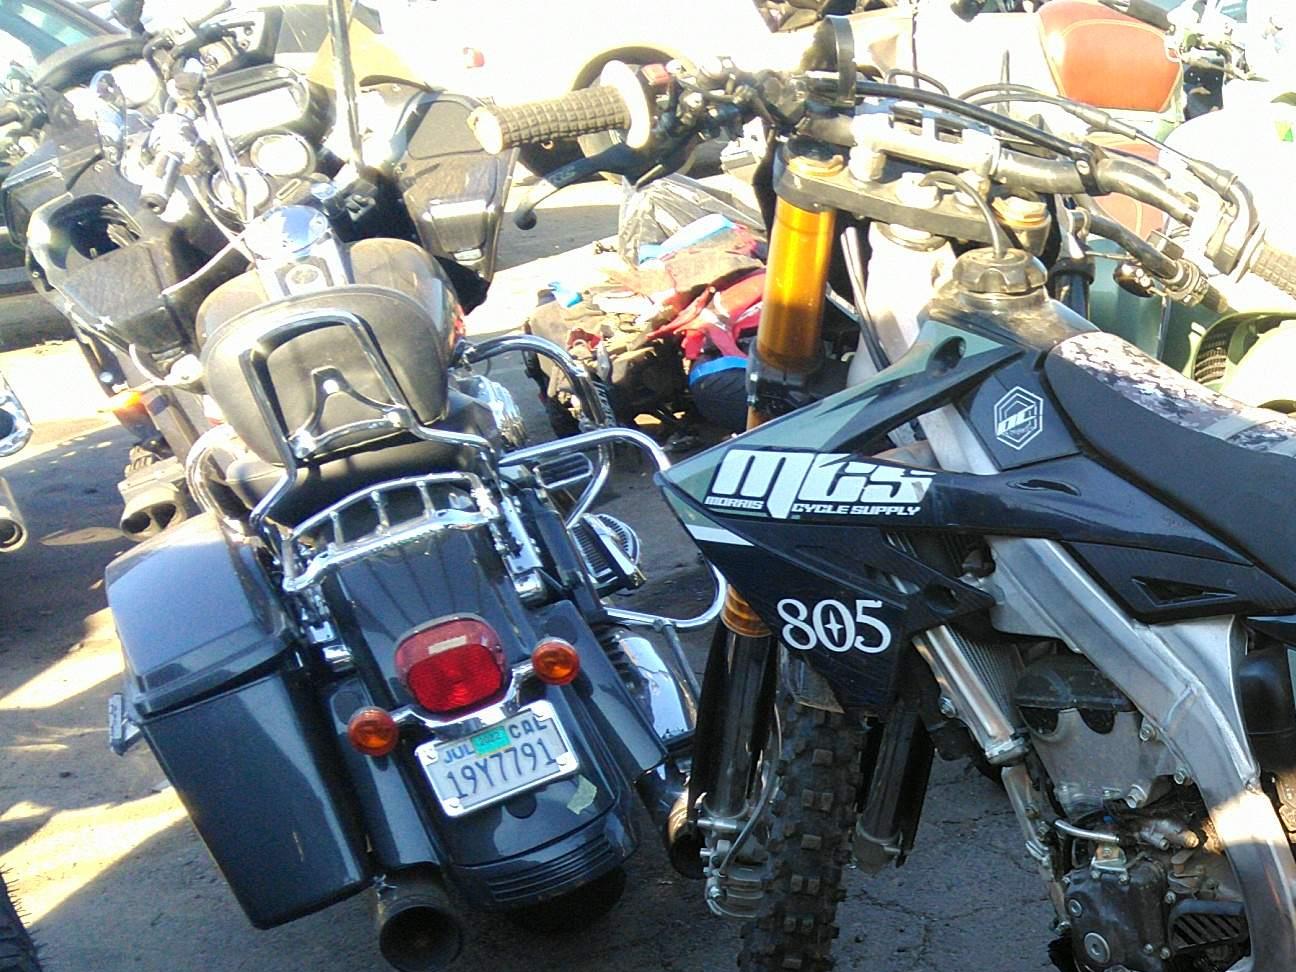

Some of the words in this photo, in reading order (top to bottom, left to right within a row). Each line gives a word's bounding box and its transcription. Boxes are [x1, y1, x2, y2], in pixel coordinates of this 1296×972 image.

[704, 495, 764, 510] MORRIS
[792, 503, 848, 516] CYCLE
[849, 504, 921, 517] SUPPLY
[776, 598, 892, 654] 805
[443, 743, 474, 765] JUL
[510, 716, 548, 740] CAL
[446, 737, 557, 801] 19Y7791
